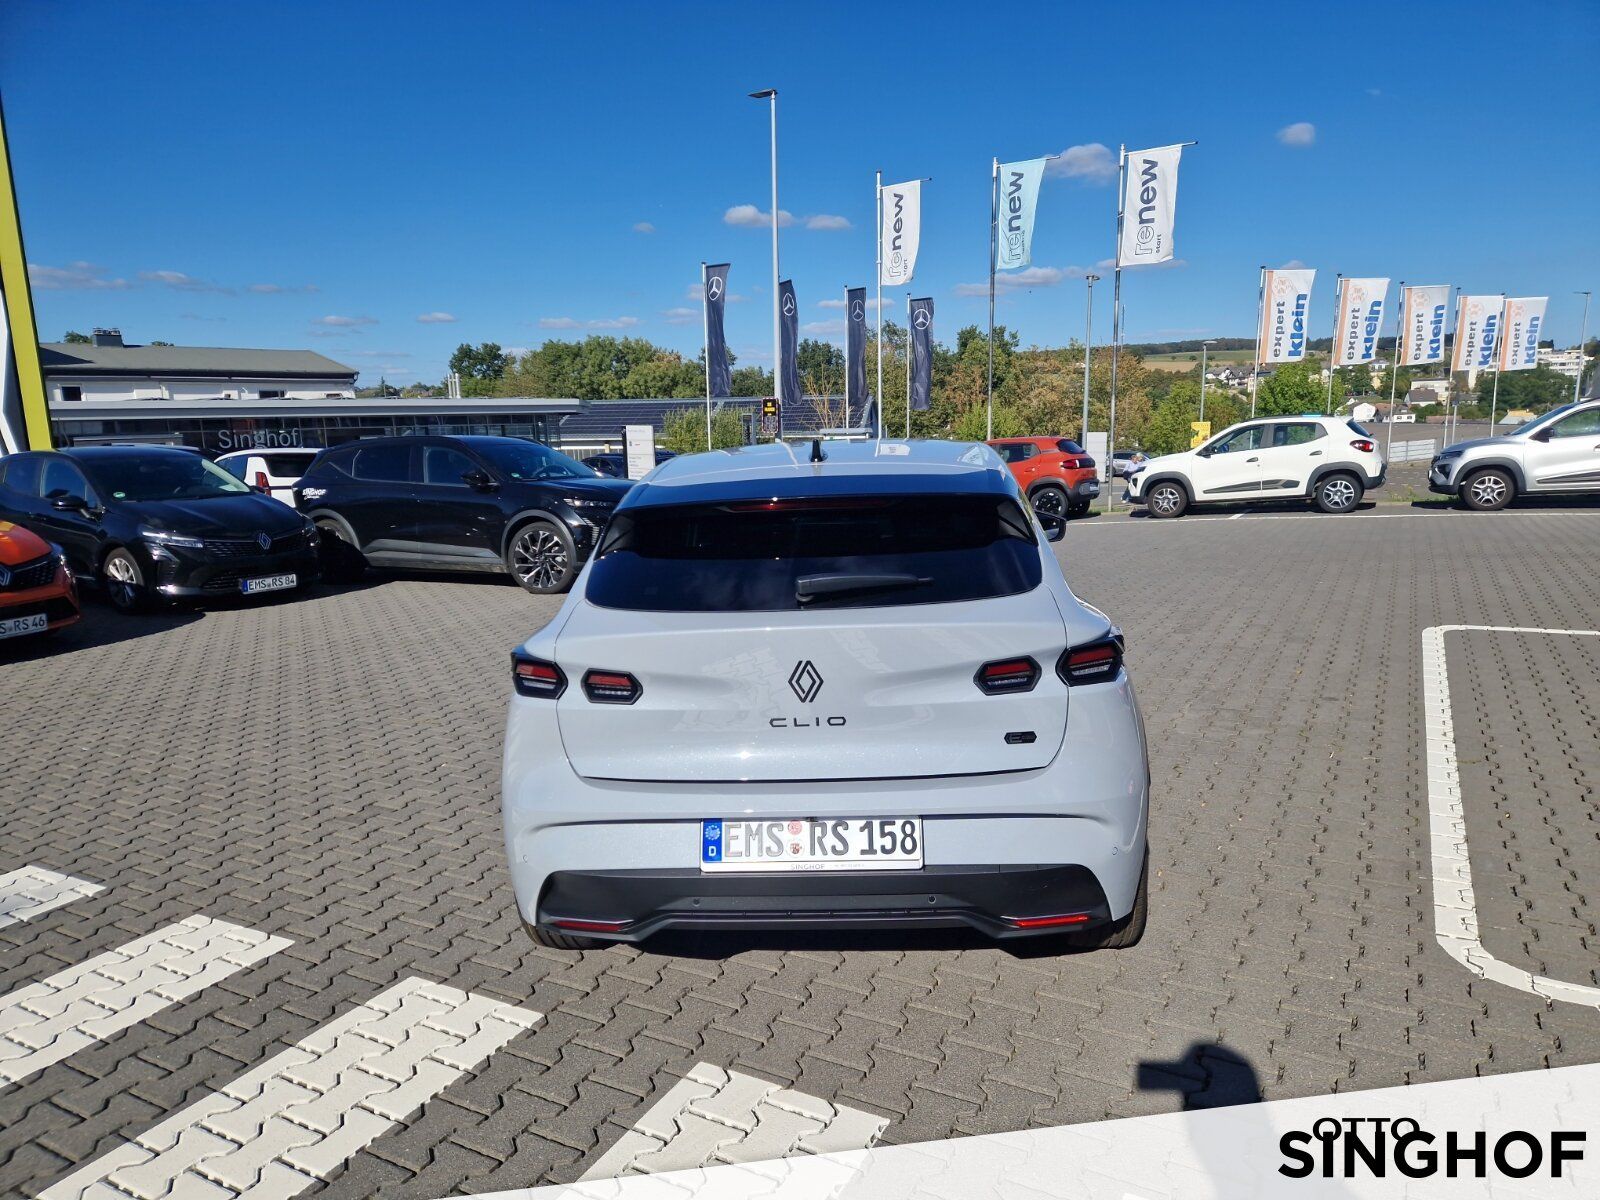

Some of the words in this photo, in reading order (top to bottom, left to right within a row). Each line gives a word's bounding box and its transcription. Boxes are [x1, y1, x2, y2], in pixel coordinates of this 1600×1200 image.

[1008, 171, 1025, 261] renew
[1135, 159, 1159, 256] renew
[889, 193, 904, 278] renew
[1273, 301, 1286, 358] expert
[1288, 293, 1308, 357] klein
[1347, 308, 1361, 360] expert
[1361, 300, 1383, 360] klein
[1413, 312, 1424, 360] expert
[1427, 304, 1446, 359] klein
[1464, 320, 1477, 366] expert
[1478, 314, 1497, 366] klein
[1510, 321, 1521, 366] expert
[1523, 316, 1540, 364] klein
[217, 428, 299, 449] Singhof
[248, 579, 267, 591] EMS
[271, 577, 284, 588] RS
[284, 575, 295, 586] 84
[13, 618, 29, 632] RS
[32, 616, 45, 628] 46
[769, 716, 847, 728] CLIO
[708, 845, 717, 857] D
[724, 823, 784, 858] EMS
[809, 820, 850, 856] RS
[859, 820, 918, 855] 158
[790, 863, 826, 871] SINGHOF
